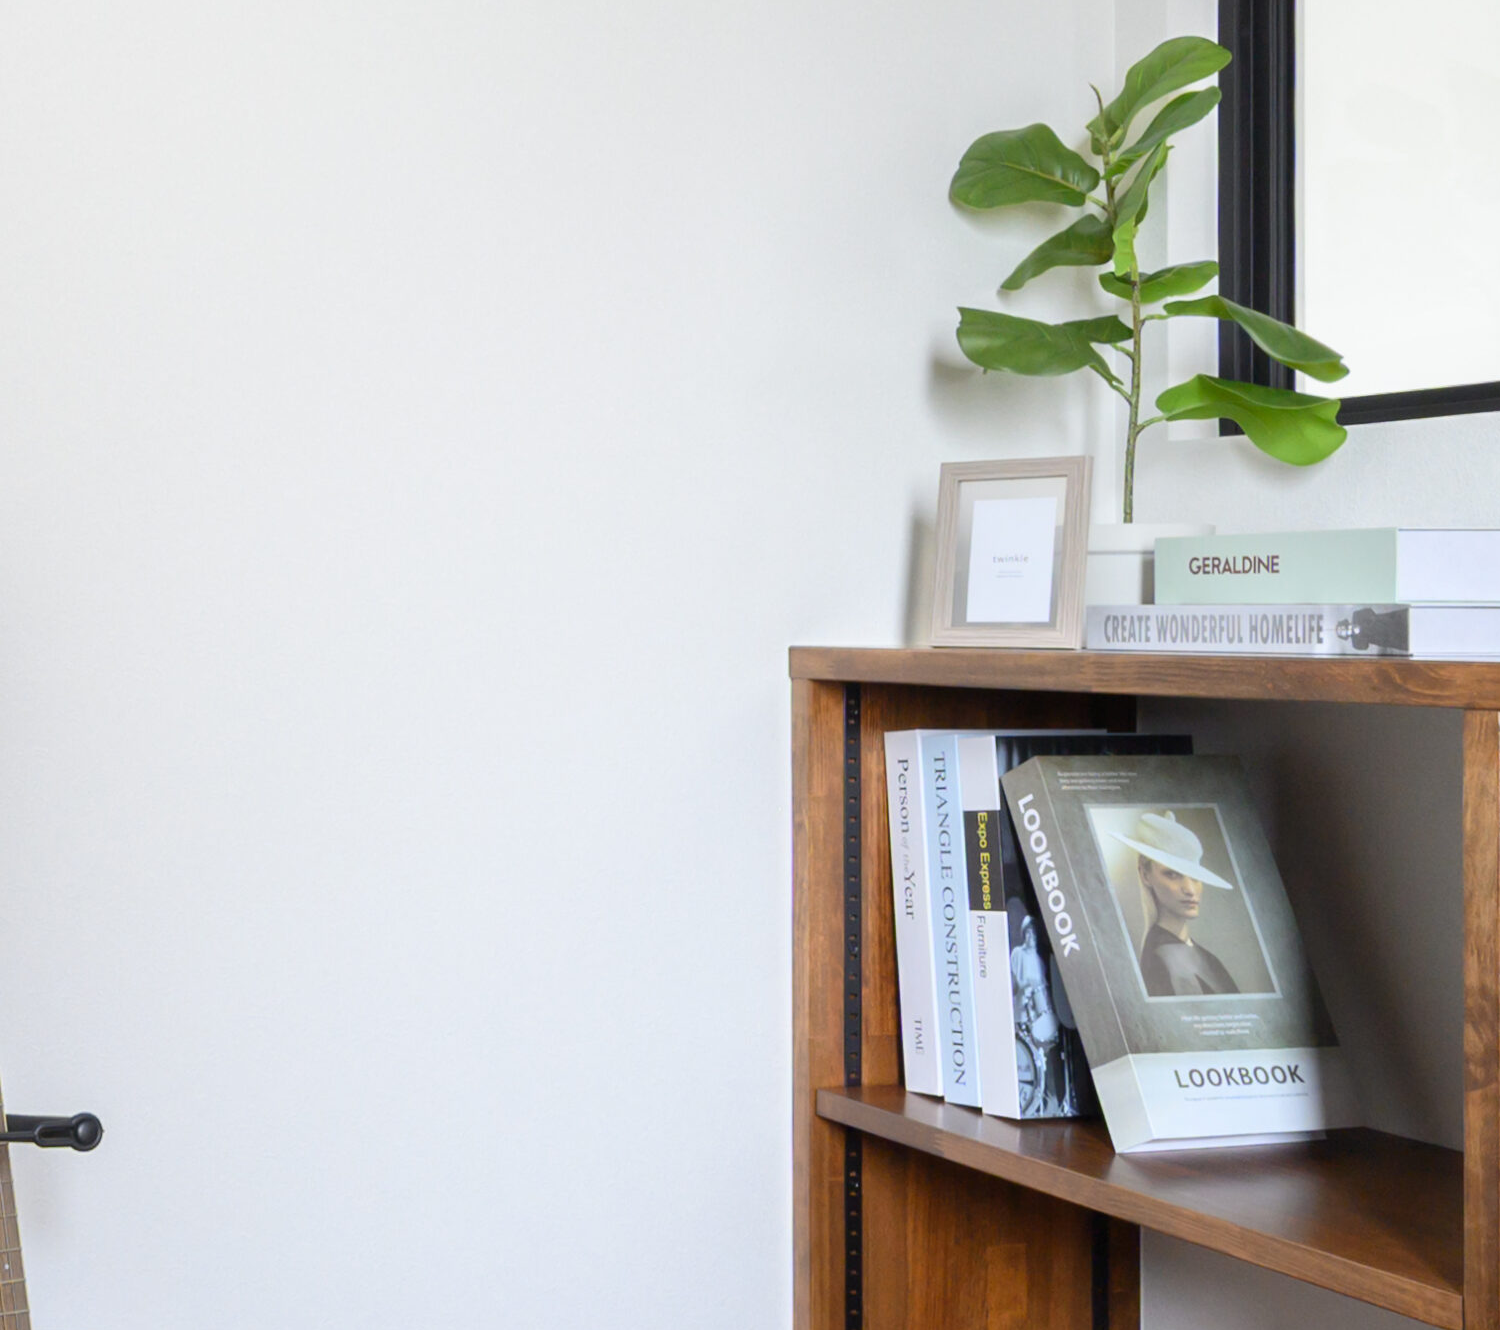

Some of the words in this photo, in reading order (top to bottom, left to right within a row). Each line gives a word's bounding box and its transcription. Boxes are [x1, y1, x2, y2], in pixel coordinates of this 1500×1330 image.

[992, 553, 1029, 565] twinkle
[1188, 555, 1281, 575] GERALDINE
[1104, 614, 1151, 644] CREATE
[1155, 614, 1244, 644] WONDERFUL
[1249, 613, 1325, 644] HOMELIFE
[897, 758, 911, 834] Person
[904, 869, 917, 921] Year
[933, 750, 955, 881] TRIANGLE
[976, 811, 989, 849] Expo
[979, 852, 992, 911] Express
[1017, 793, 1081, 958] LOOKBOOK
[975, 915, 988, 979] Furniture
[941, 886, 967, 1086] CONSTRUCTION
[914, 1017, 926, 1056] TIME
[1174, 1064, 1306, 1088] LOOKBOOK
